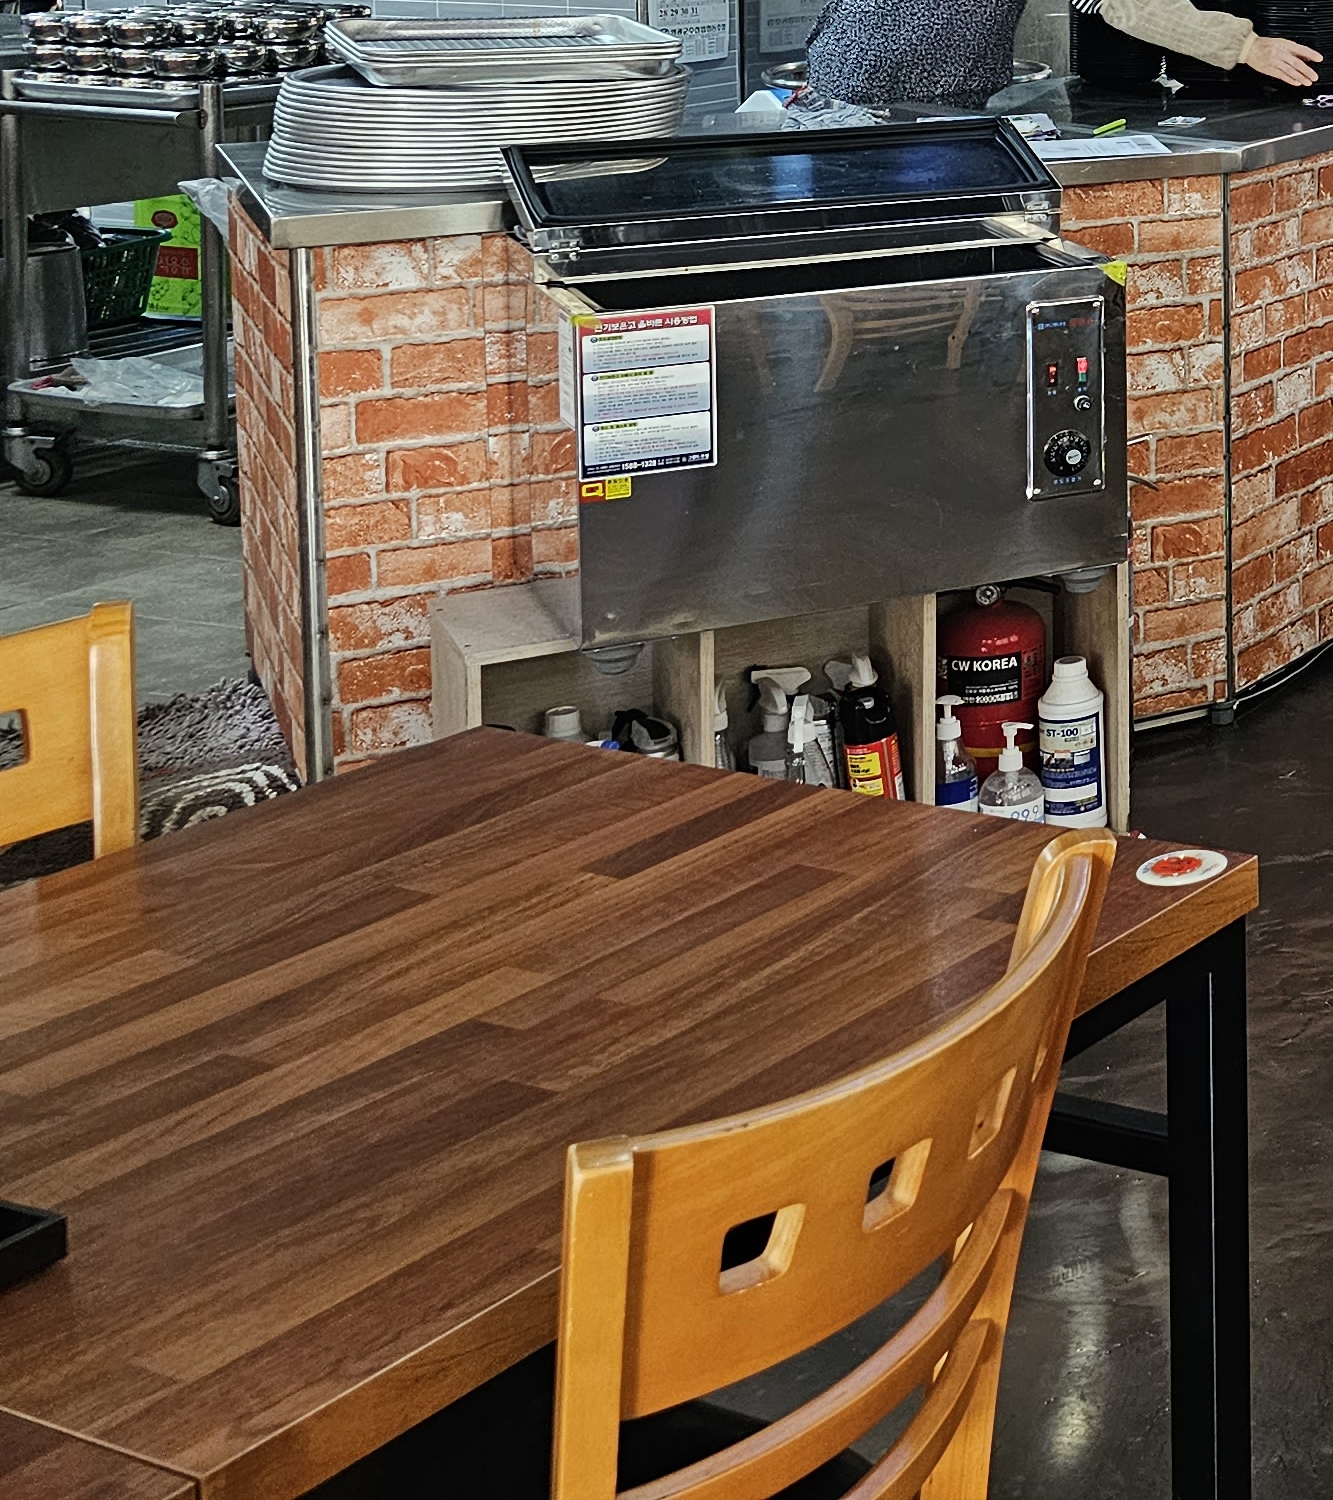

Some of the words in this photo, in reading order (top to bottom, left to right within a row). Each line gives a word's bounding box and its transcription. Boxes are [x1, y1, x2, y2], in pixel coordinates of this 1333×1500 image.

[951, 660, 970, 672] CW
[973, 656, 1018, 672] KOREA
[1046, 727, 1078, 738] ST-100
